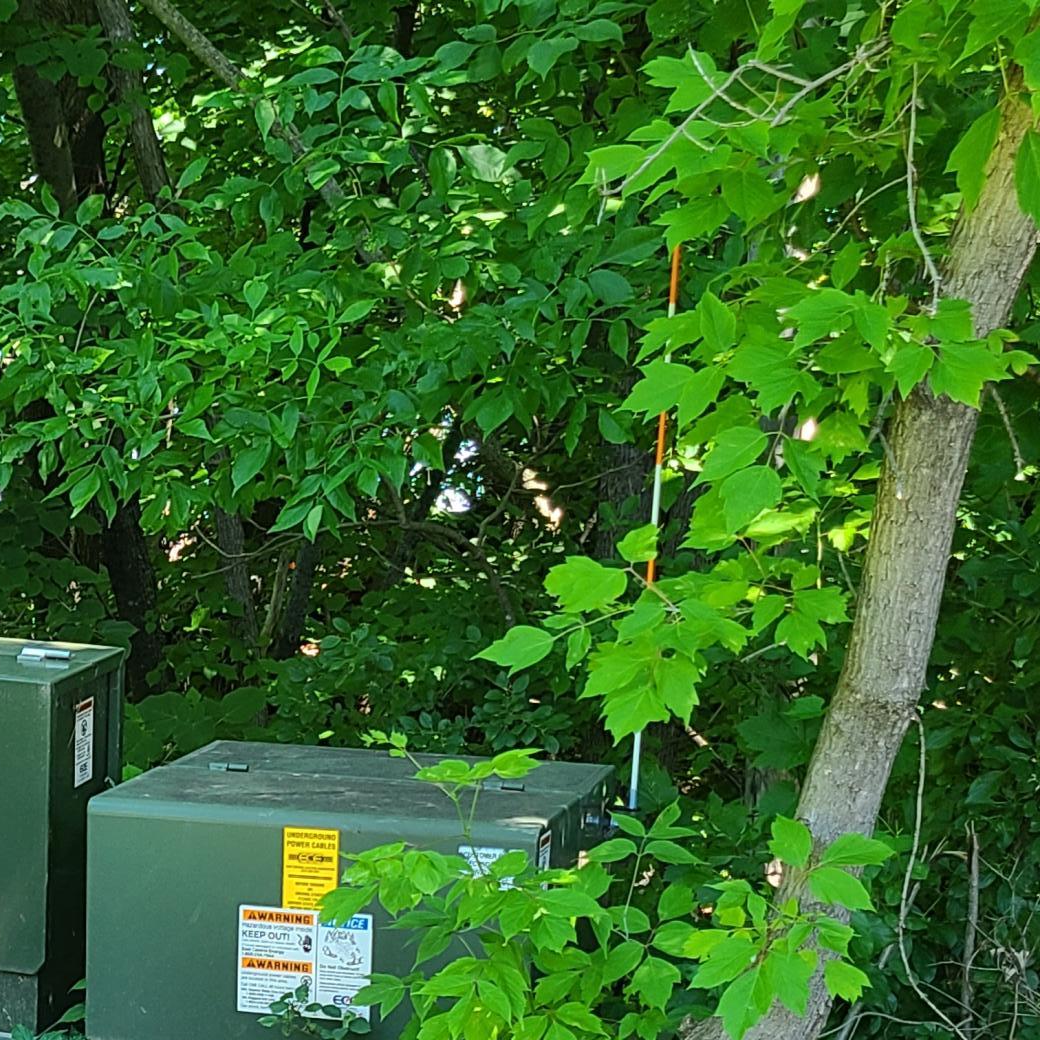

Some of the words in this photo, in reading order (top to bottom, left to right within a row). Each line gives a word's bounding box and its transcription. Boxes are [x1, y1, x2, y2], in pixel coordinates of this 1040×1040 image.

[286, 832, 337, 841] UNDERGROUND
[286, 841, 311, 849] POWER
[311, 842, 336, 850] CABLES
[259, 911, 311, 925] WARNING
[241, 930, 266, 939] KEEP
[267, 931, 290, 941] OUT!
[257, 959, 309, 973] WARNING
[333, 994, 353, 1006] EC
